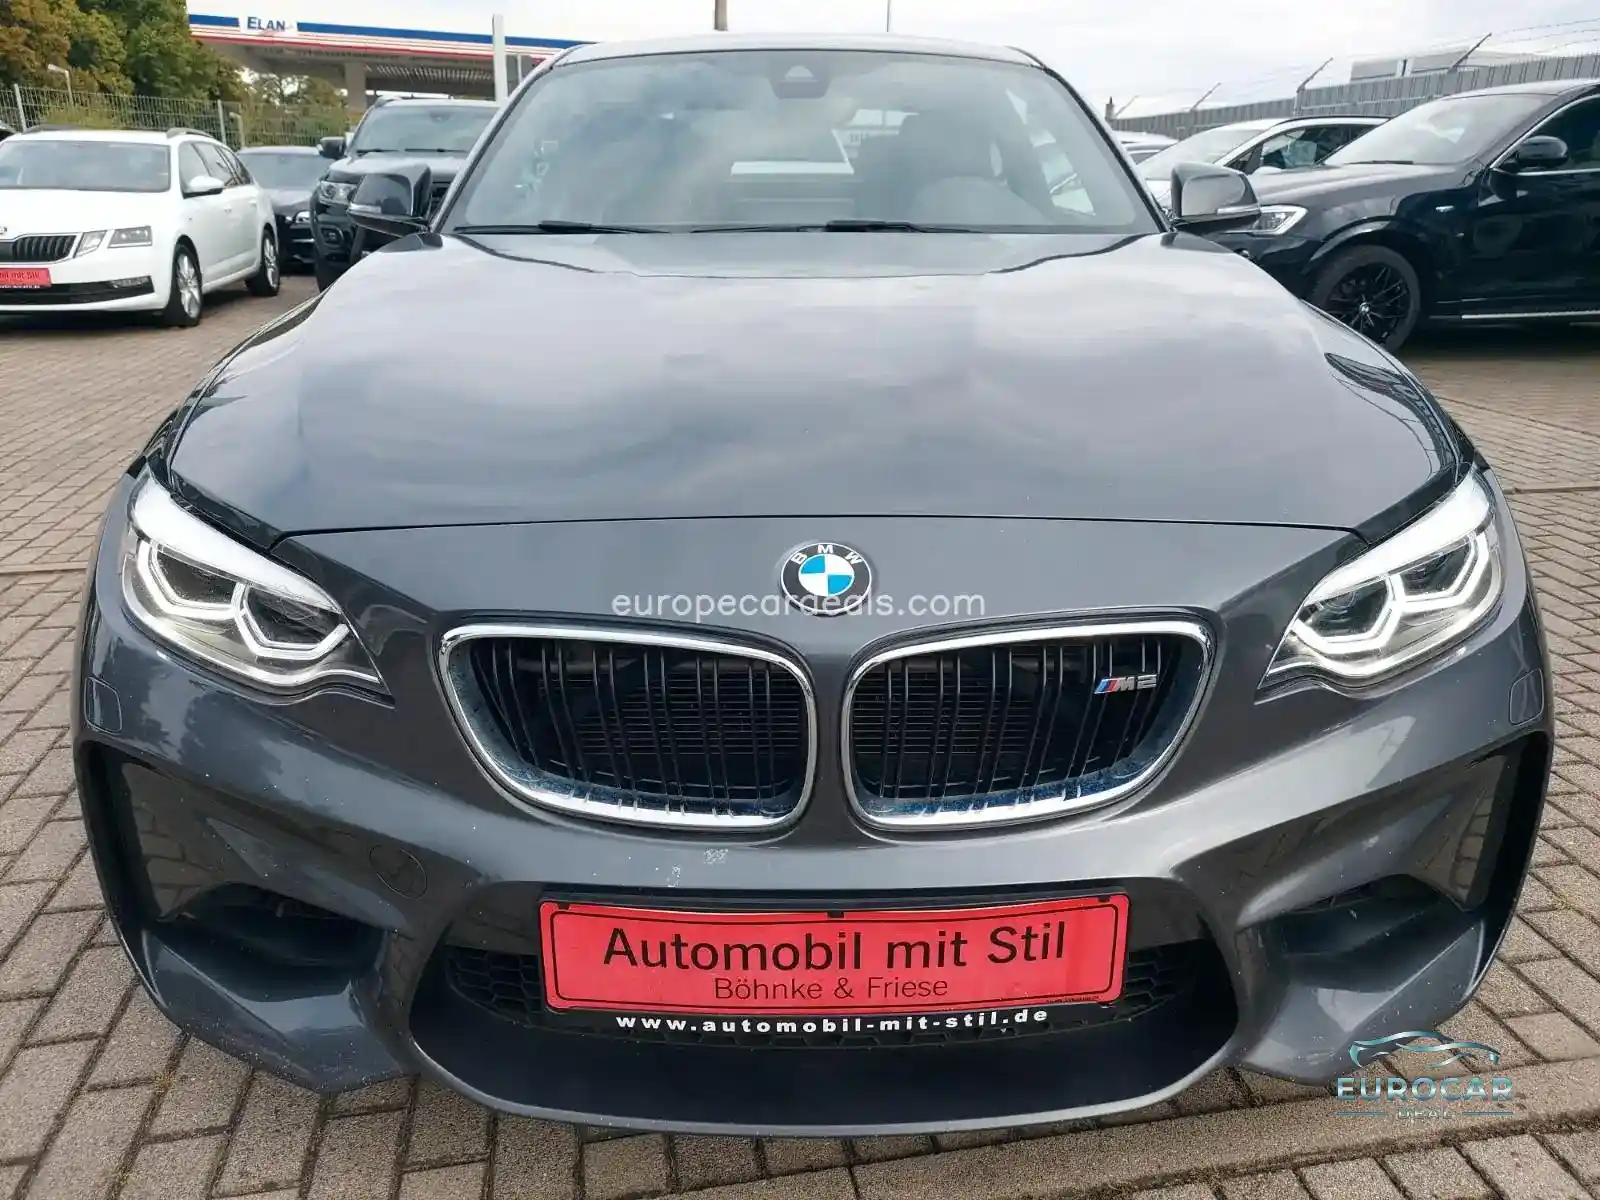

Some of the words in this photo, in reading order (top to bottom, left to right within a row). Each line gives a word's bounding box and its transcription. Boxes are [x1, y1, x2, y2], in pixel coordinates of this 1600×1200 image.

[247, 16, 286, 32] ELAN
[790, 544, 863, 565] BMW
[603, 927, 862, 971] Automobil
[886, 930, 968, 969] mit
[988, 921, 1065, 964] Stil
[714, 977, 823, 1000] Böhnke
[833, 976, 854, 999] &
[867, 976, 948, 999] Friese
[615, 1008, 1048, 1033] www.automobil-mit-stil.de
